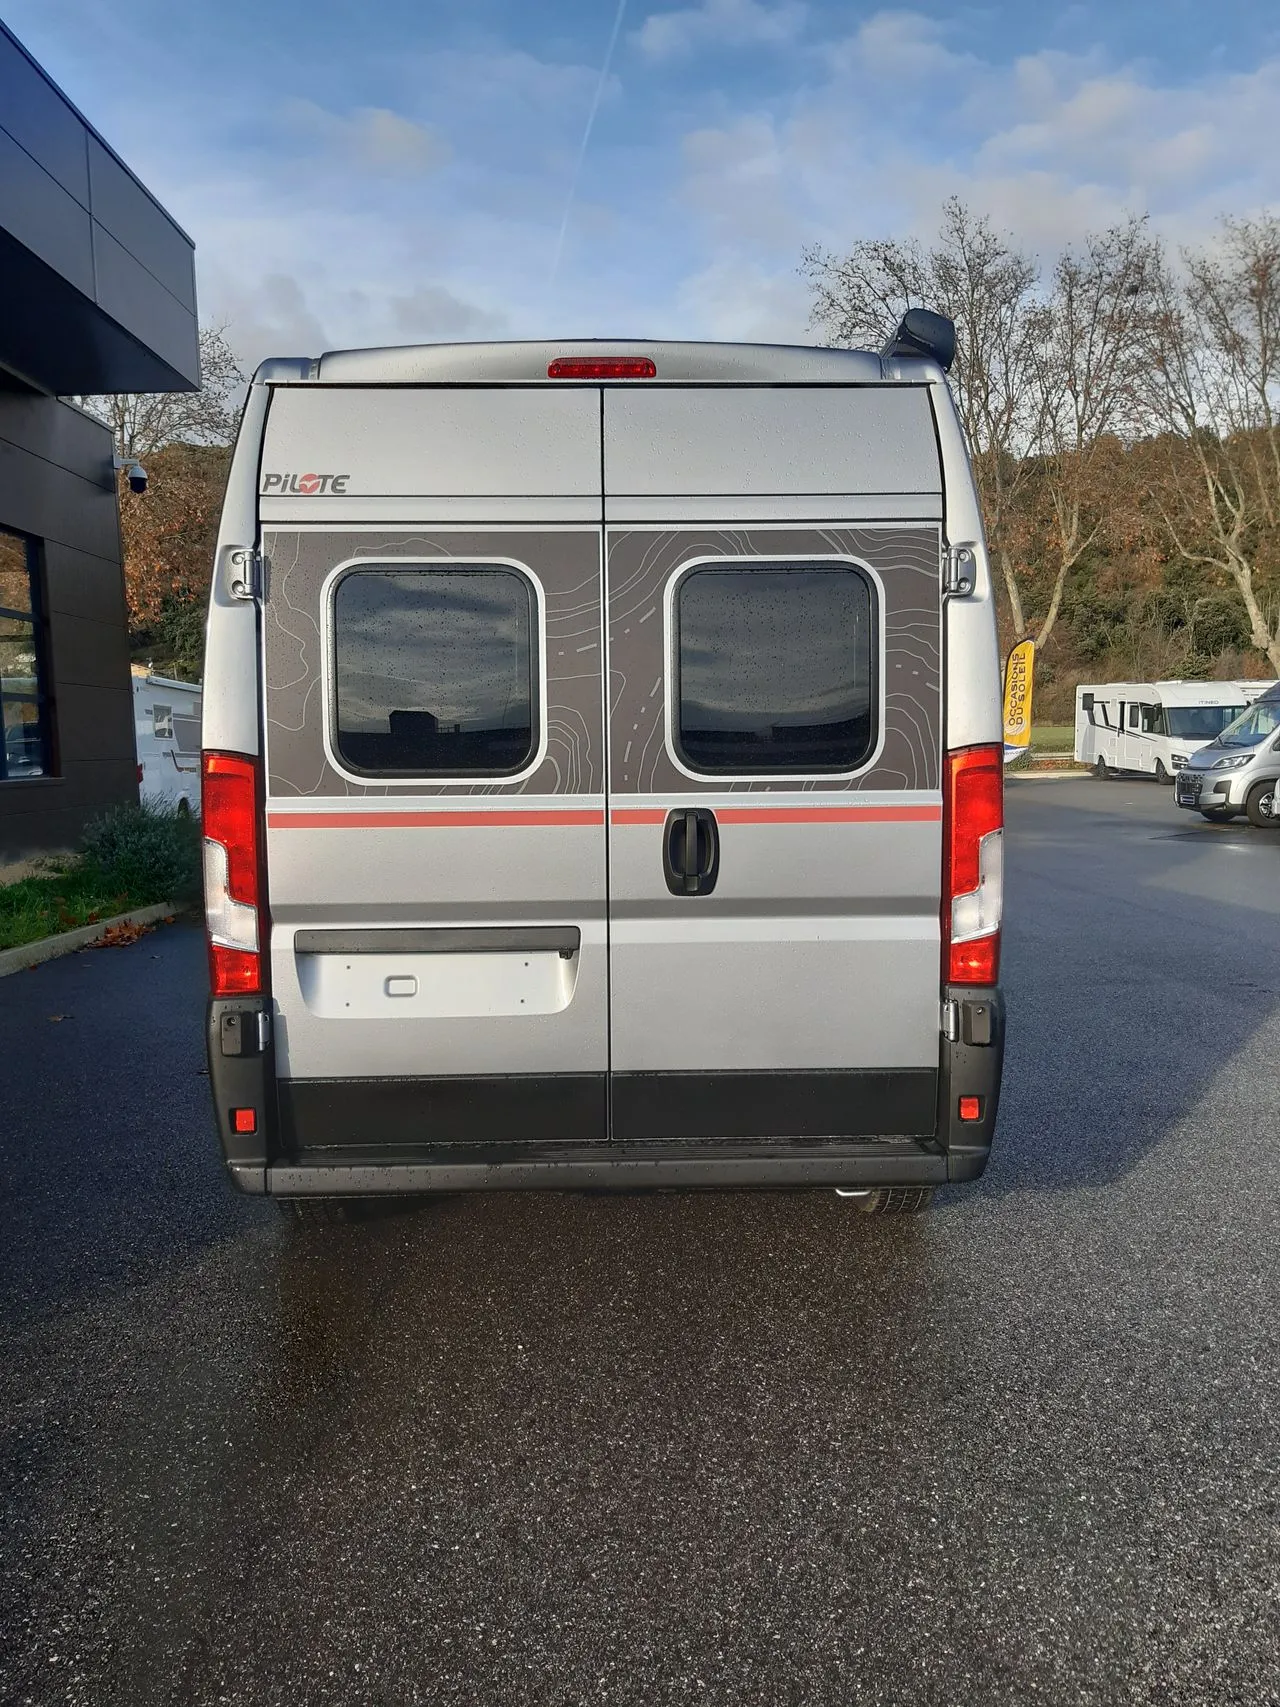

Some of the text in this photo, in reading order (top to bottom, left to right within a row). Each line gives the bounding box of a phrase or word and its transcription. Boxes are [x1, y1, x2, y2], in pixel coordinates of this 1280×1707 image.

[1008, 653, 1020, 727] OCCASIONS
[1016, 652, 1026, 725] DU SOLEIL
